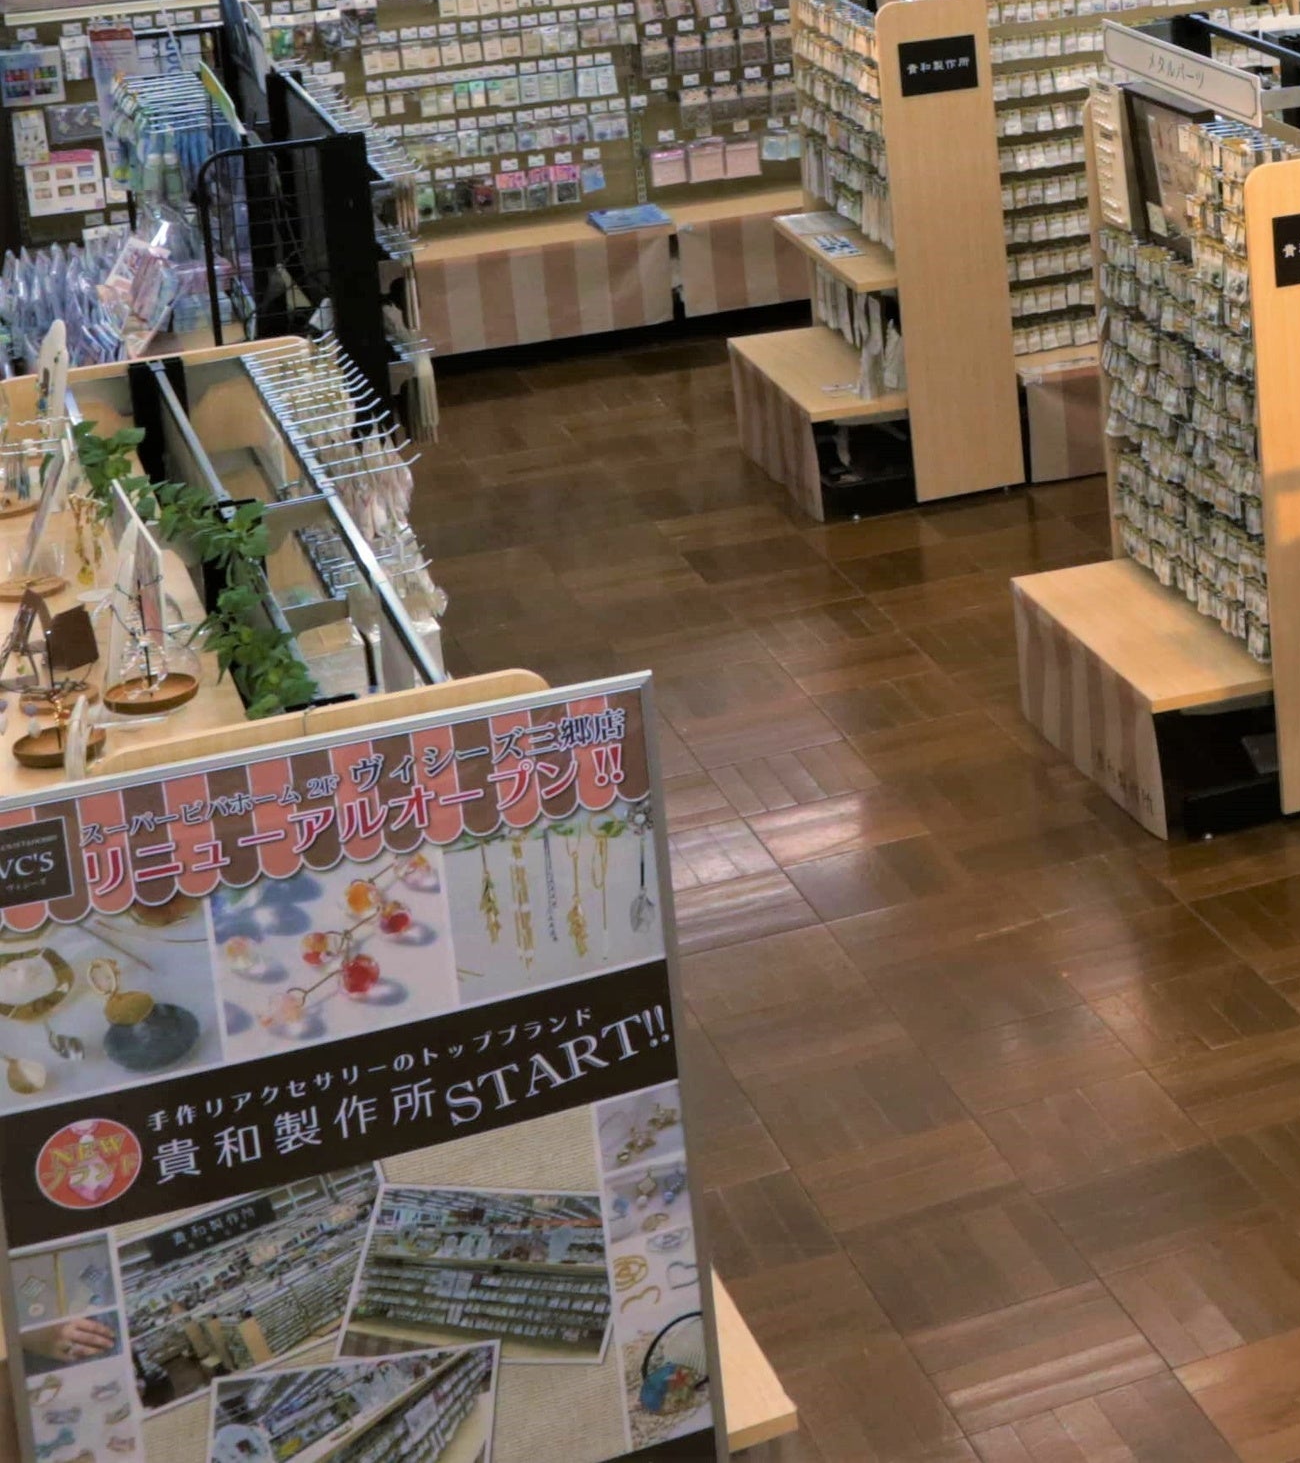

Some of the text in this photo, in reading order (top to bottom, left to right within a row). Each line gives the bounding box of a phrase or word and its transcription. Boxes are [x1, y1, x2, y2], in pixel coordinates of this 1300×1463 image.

[906, 56, 970, 76] 貴和製作所
[79, 707, 627, 847] スーパービバホーム 2F ヴィシーズ三郷店
